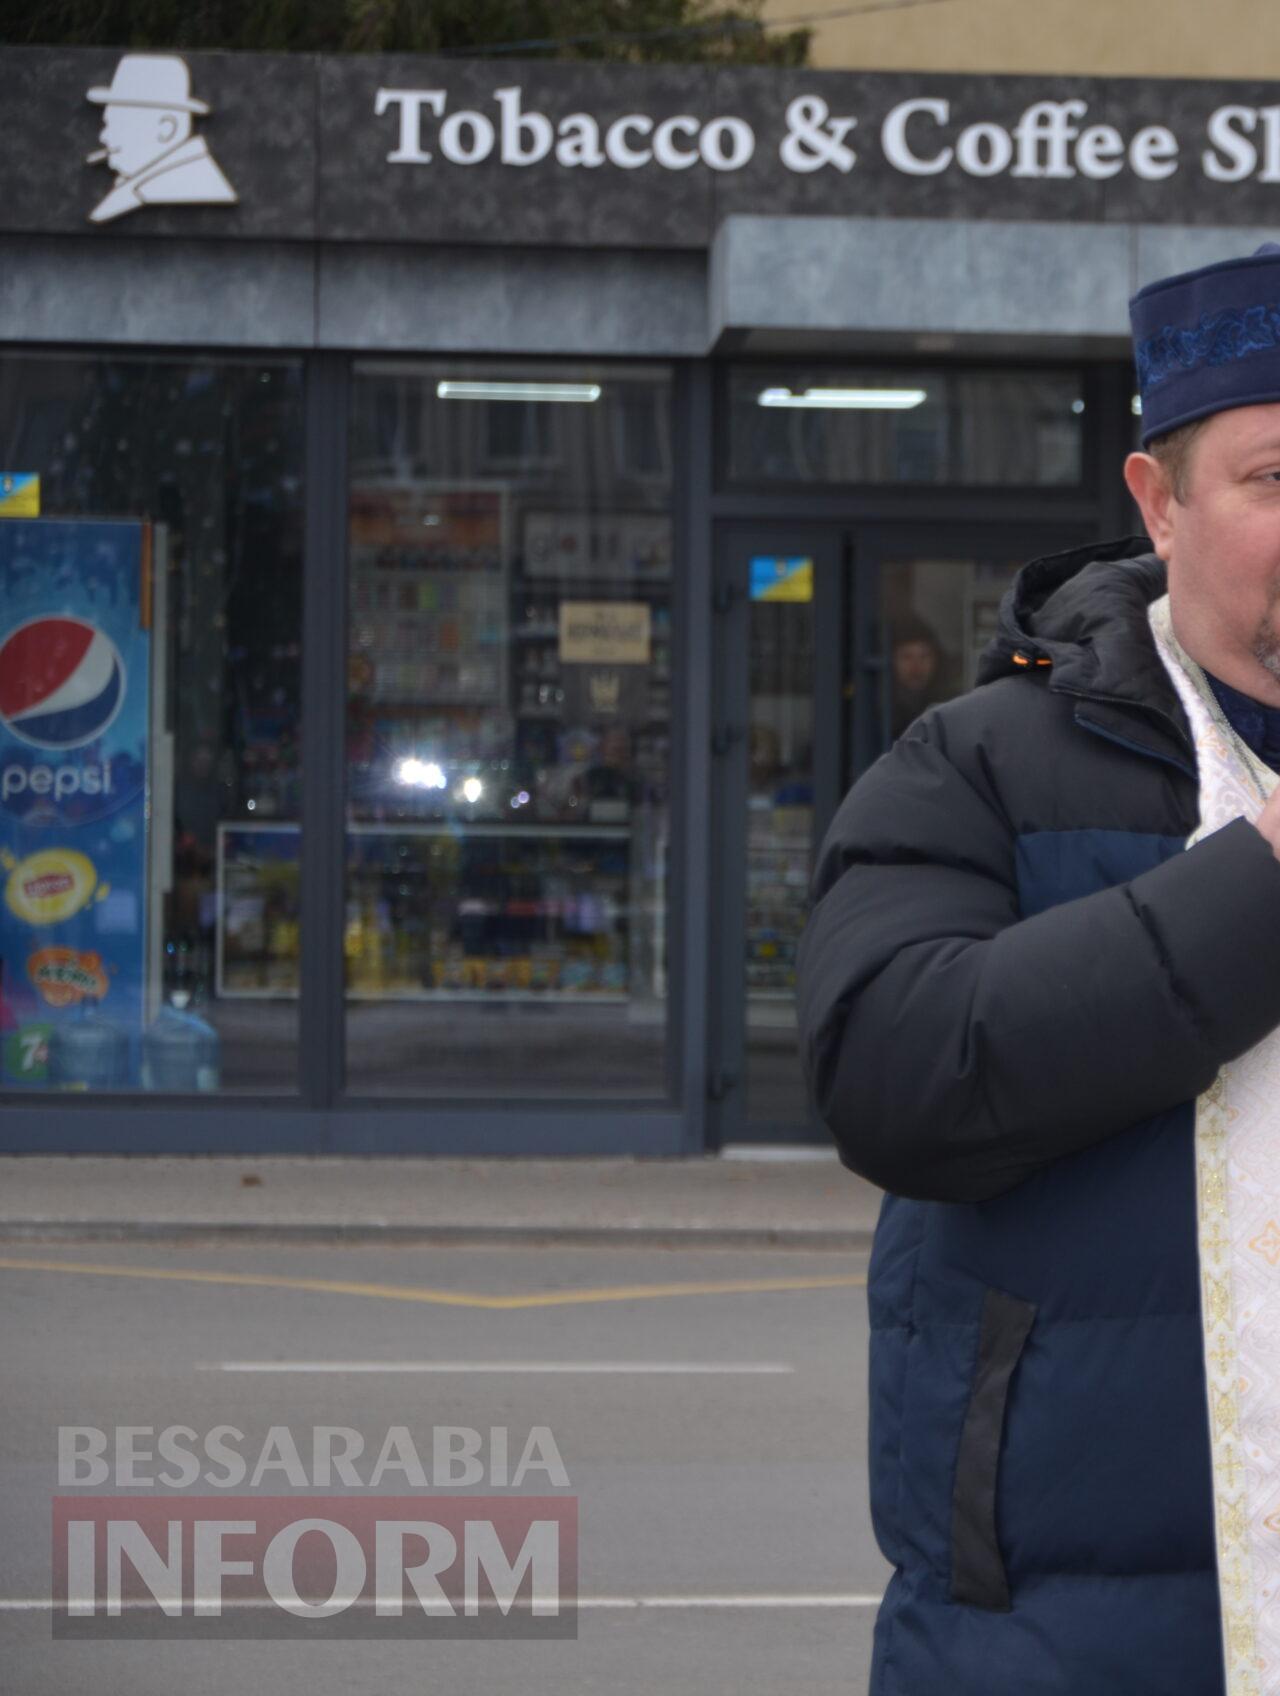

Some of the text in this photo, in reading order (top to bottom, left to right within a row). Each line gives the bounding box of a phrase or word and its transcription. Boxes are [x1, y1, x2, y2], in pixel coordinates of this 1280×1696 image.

[376, 88, 754, 169] Tobacco
[781, 96, 856, 171] &
[883, 99, 1177, 179] Coffee
[2, 758, 113, 801] pepsi
